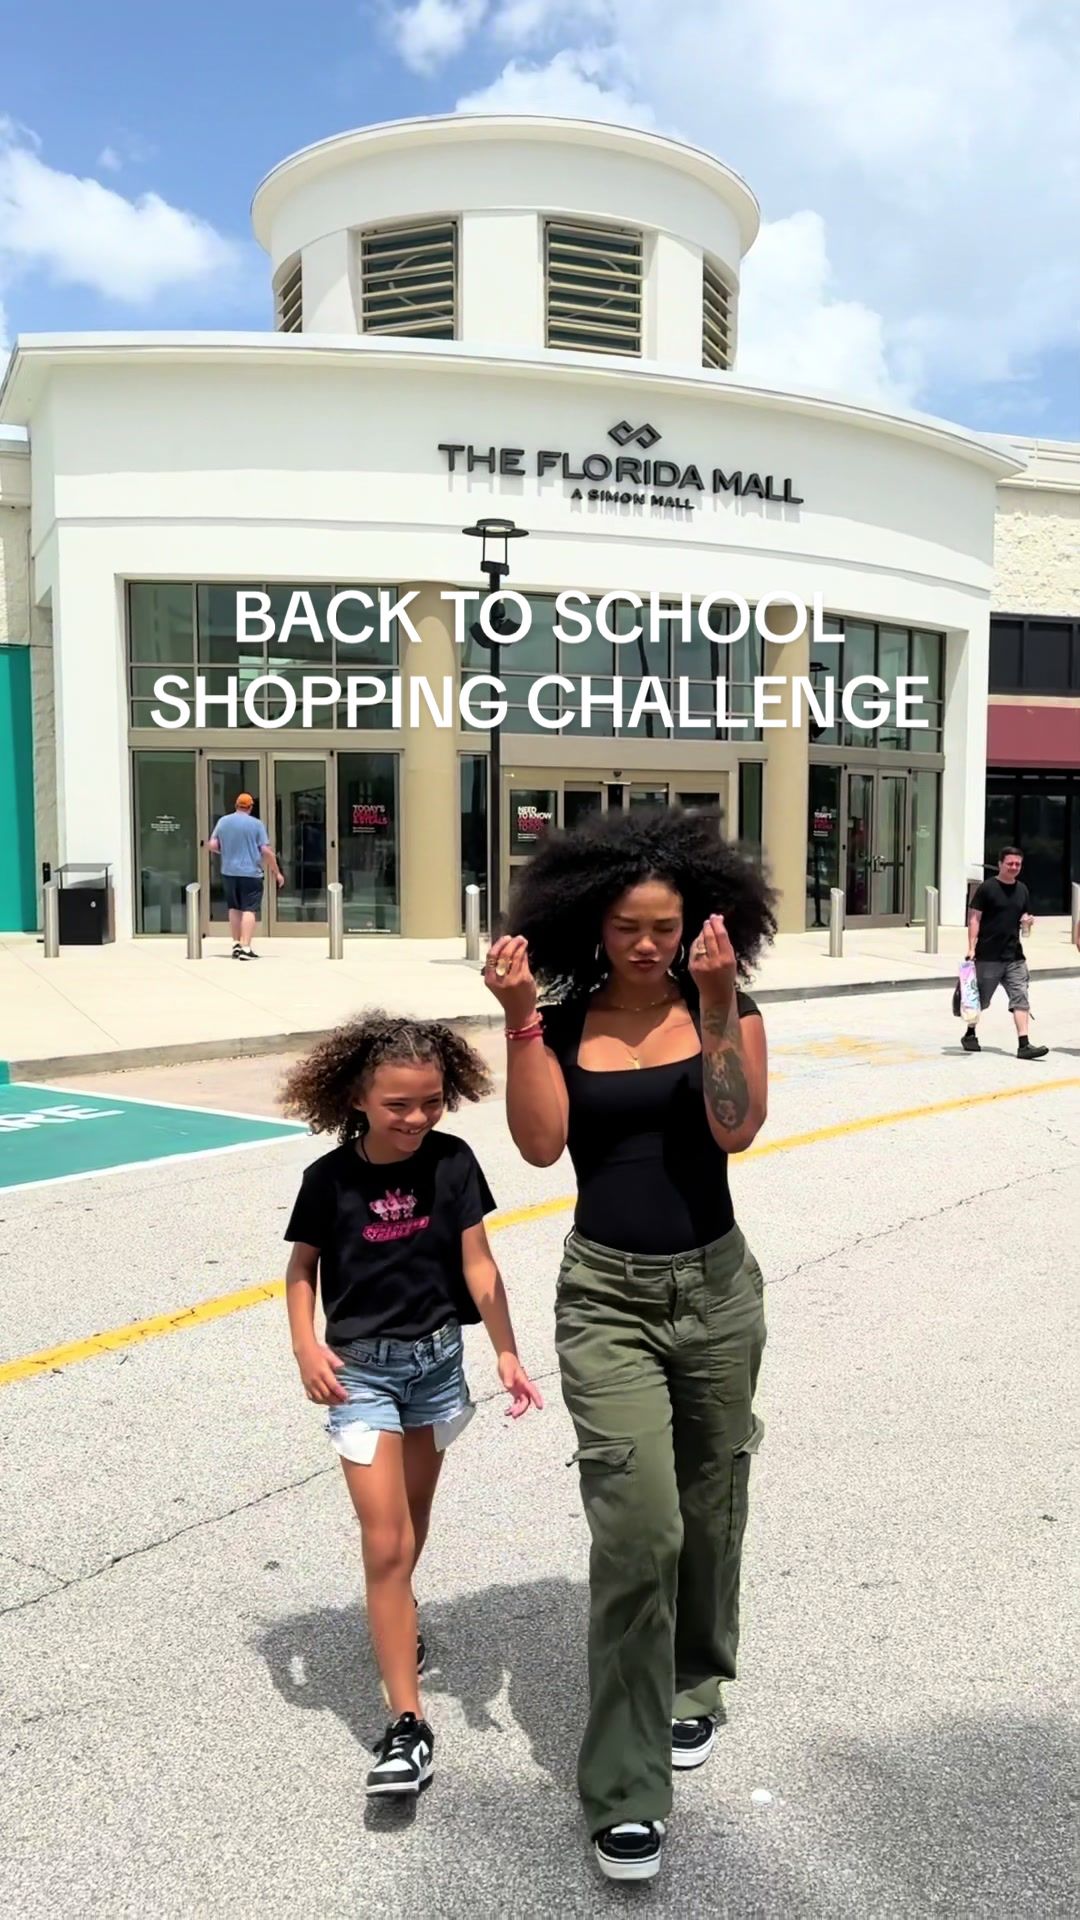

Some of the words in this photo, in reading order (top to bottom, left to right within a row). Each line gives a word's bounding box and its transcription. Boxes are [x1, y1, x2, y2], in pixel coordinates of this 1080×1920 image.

[437, 443, 526, 477] THE
[537, 450, 705, 492] FLORIDA
[712, 468, 804, 504] MALL
[570, 488, 583, 500] A
[587, 488, 646, 505] SIMON
[650, 494, 695, 510] MALL
[352, 804, 386, 813] TODAY'S
[517, 805, 537, 814] NEED
[518, 812, 528, 820] TO
[529, 812, 552, 820] KNOW
[0, 1104, 126, 1132] RE
